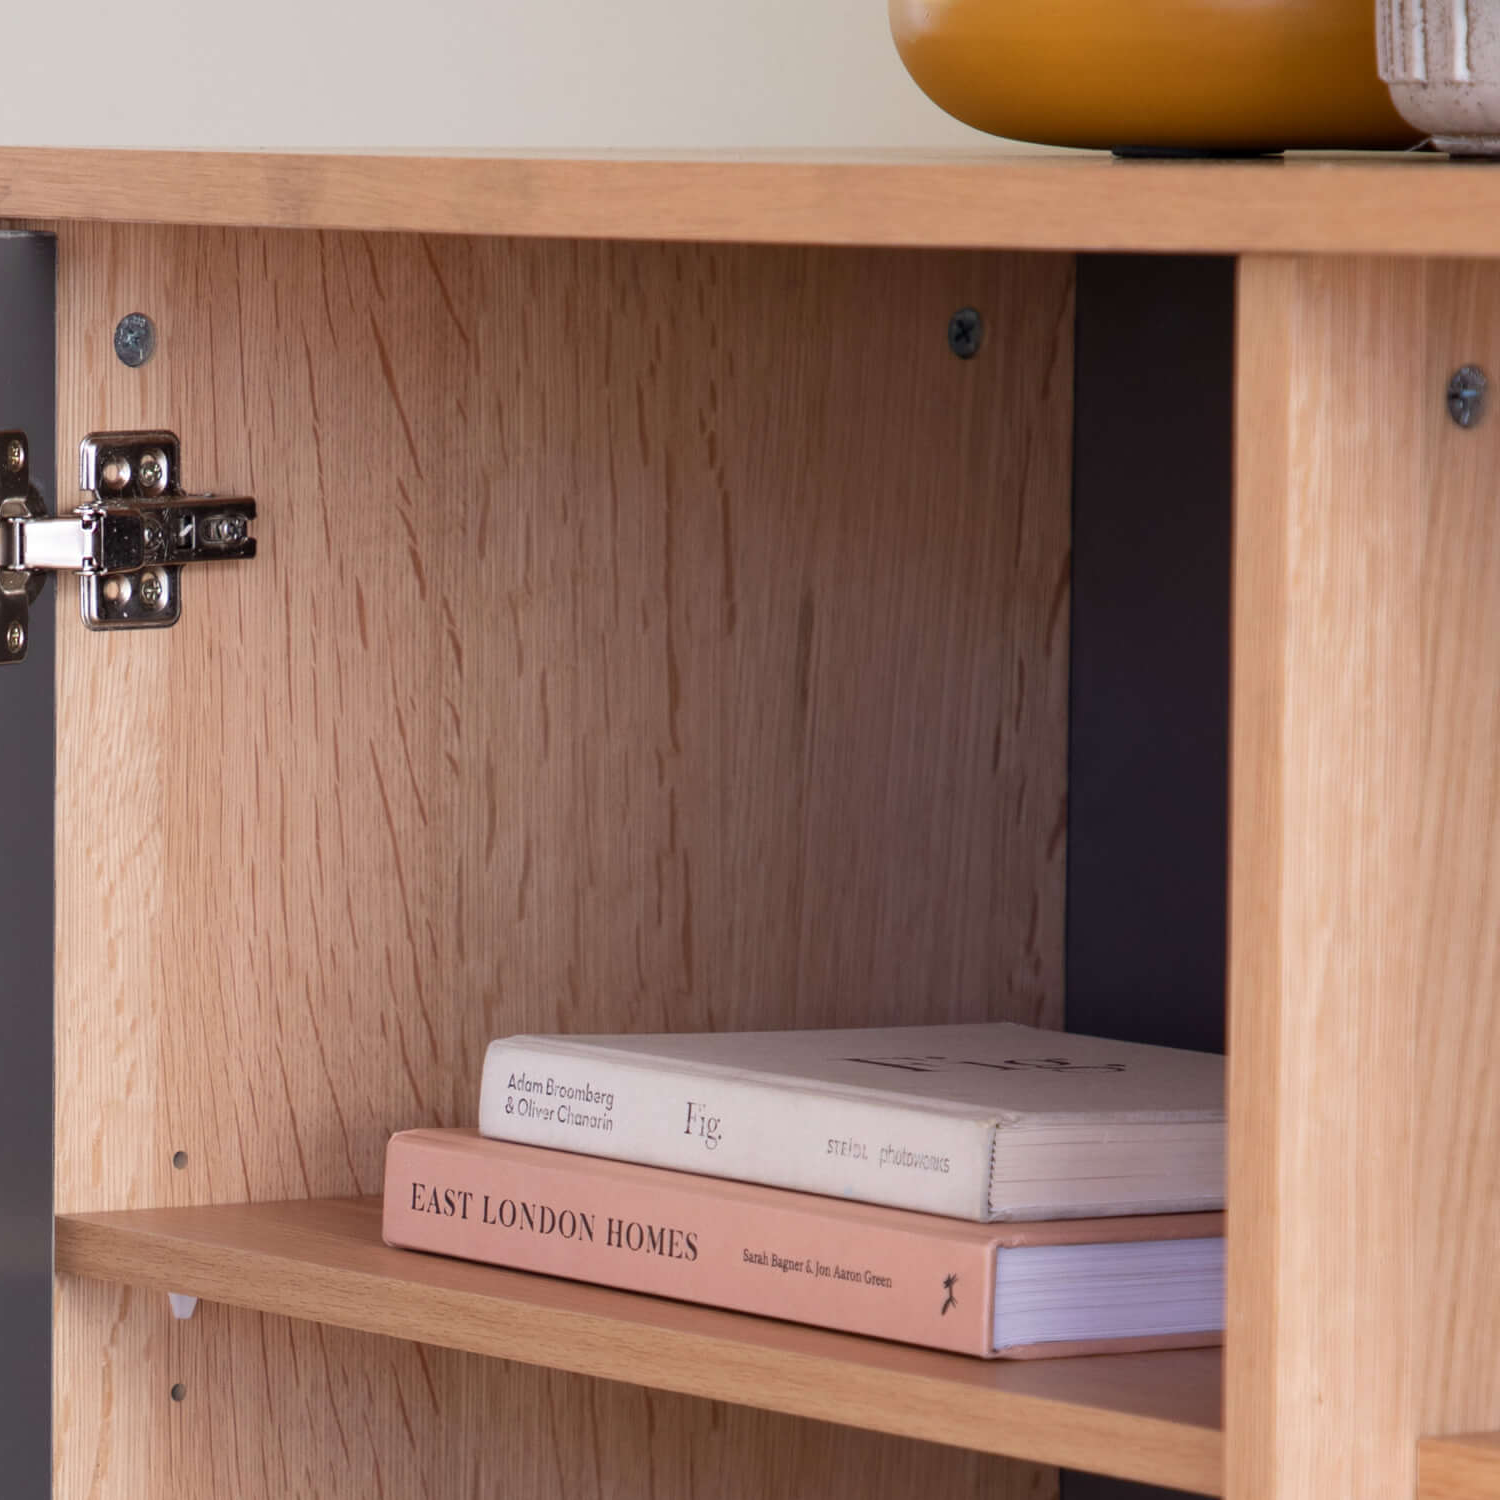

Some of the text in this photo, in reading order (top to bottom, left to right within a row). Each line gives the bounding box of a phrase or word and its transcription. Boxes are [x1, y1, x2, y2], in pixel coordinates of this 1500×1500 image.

[508, 1072, 614, 1111] Adam Broomberg
[505, 1096, 613, 1131] & Oliver Chanarin
[684, 1102, 721, 1150] Fig.
[411, 1182, 698, 1262] EAST LONDON HOMES
[743, 1248, 892, 1288] Sarah Bagner & Jon Aaron Green
